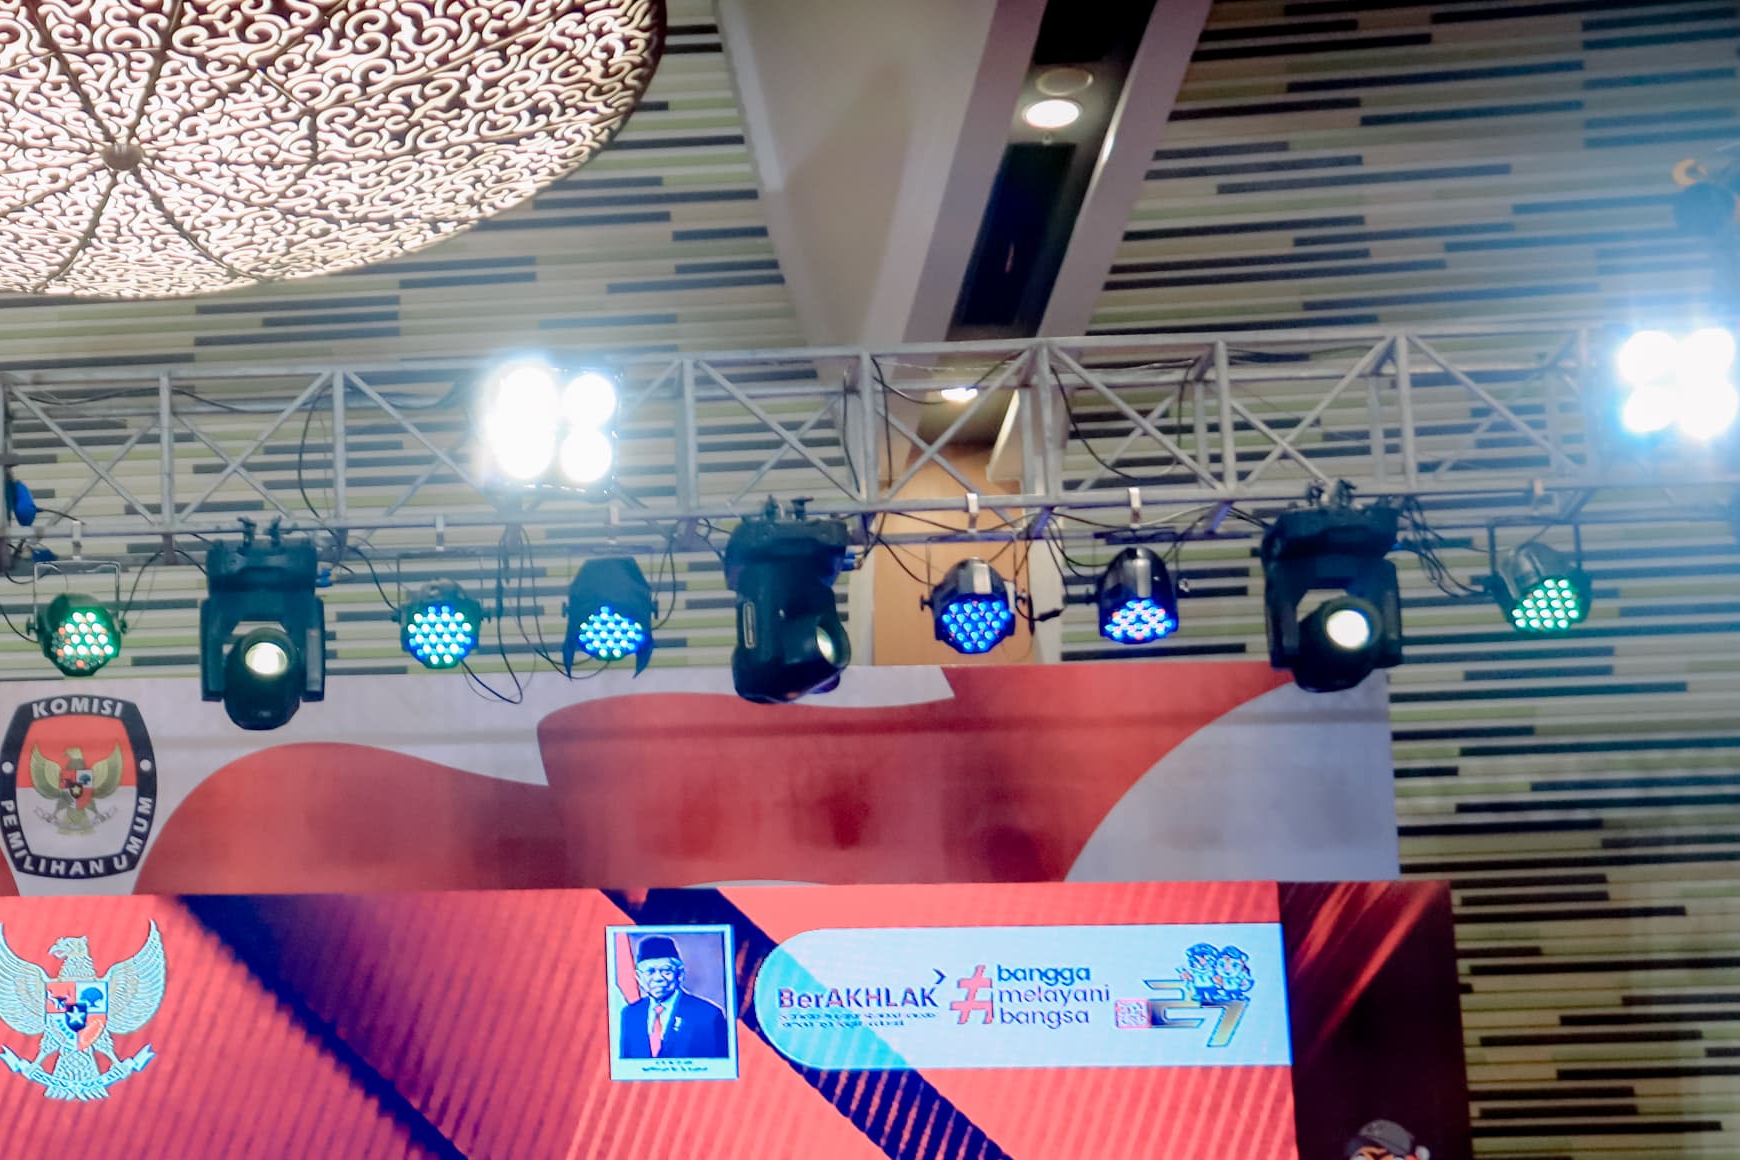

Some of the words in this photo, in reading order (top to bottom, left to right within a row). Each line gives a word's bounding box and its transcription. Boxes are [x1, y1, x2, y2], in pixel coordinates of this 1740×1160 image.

[31, 697, 123, 718] KOMISI
[0, 799, 105, 876] PEMILIHAN
[112, 796, 153, 870] UMUM
[997, 964, 1091, 986] bangga
[777, 987, 940, 1009] BerAKHLAK
[999, 985, 1111, 1006] melayani
[999, 1007, 1090, 1029] bangsa
